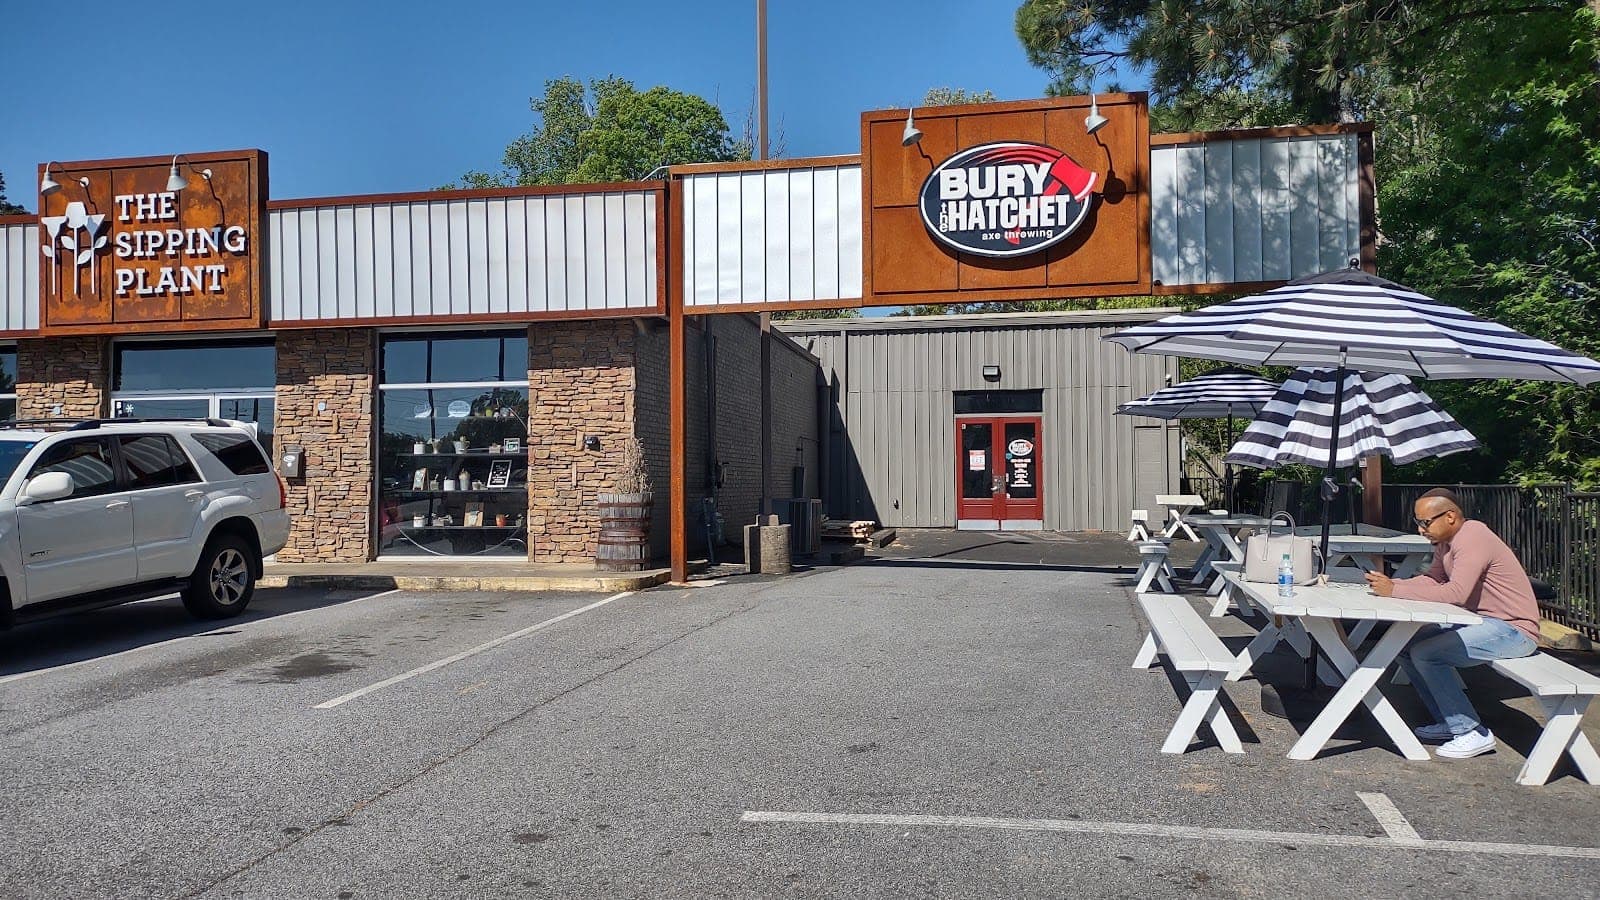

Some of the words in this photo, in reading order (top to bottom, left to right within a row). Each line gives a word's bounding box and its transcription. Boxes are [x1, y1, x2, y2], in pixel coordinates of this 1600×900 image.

[939, 162, 1052, 200] BURY
[115, 192, 176, 221] THE
[939, 202, 949, 233] the
[948, 194, 1070, 232] HATCHET
[115, 225, 246, 258] SIPPING
[982, 232, 1001, 241] axe
[1004, 229, 1053, 240] throwing
[115, 265, 225, 295] PLANT
